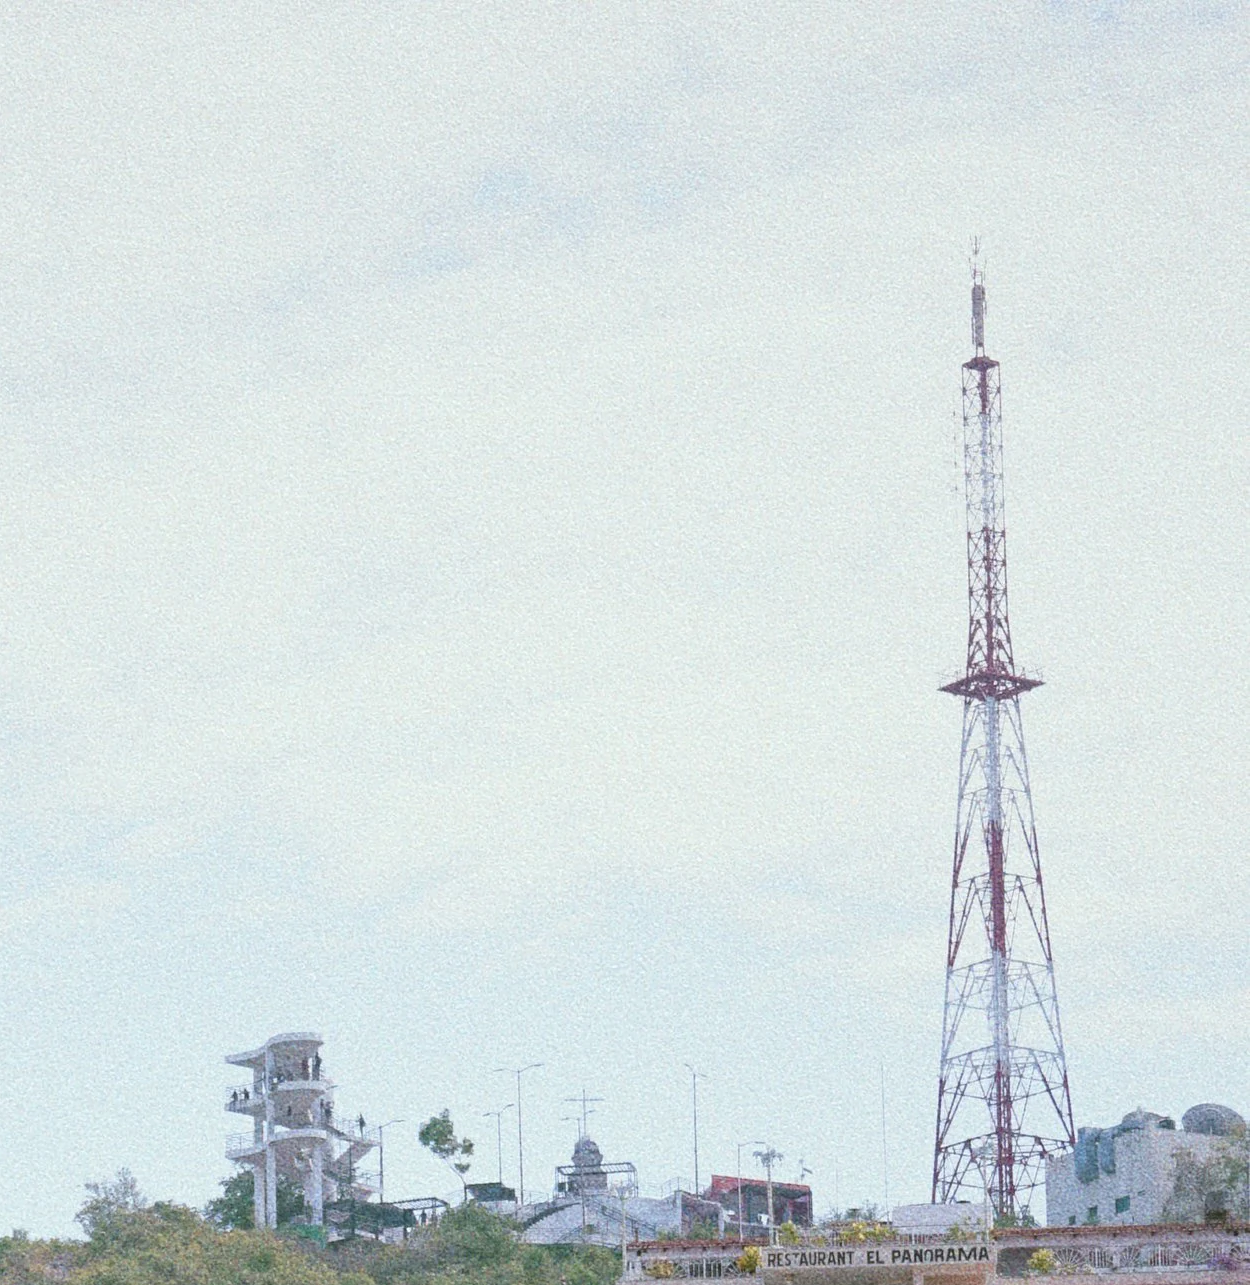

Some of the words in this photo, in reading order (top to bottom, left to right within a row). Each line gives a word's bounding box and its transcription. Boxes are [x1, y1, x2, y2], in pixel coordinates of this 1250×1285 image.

[767, 1251, 855, 1267] RESTAURANT
[866, 1250, 885, 1264] EL
[891, 1247, 990, 1263] PANORAMA
